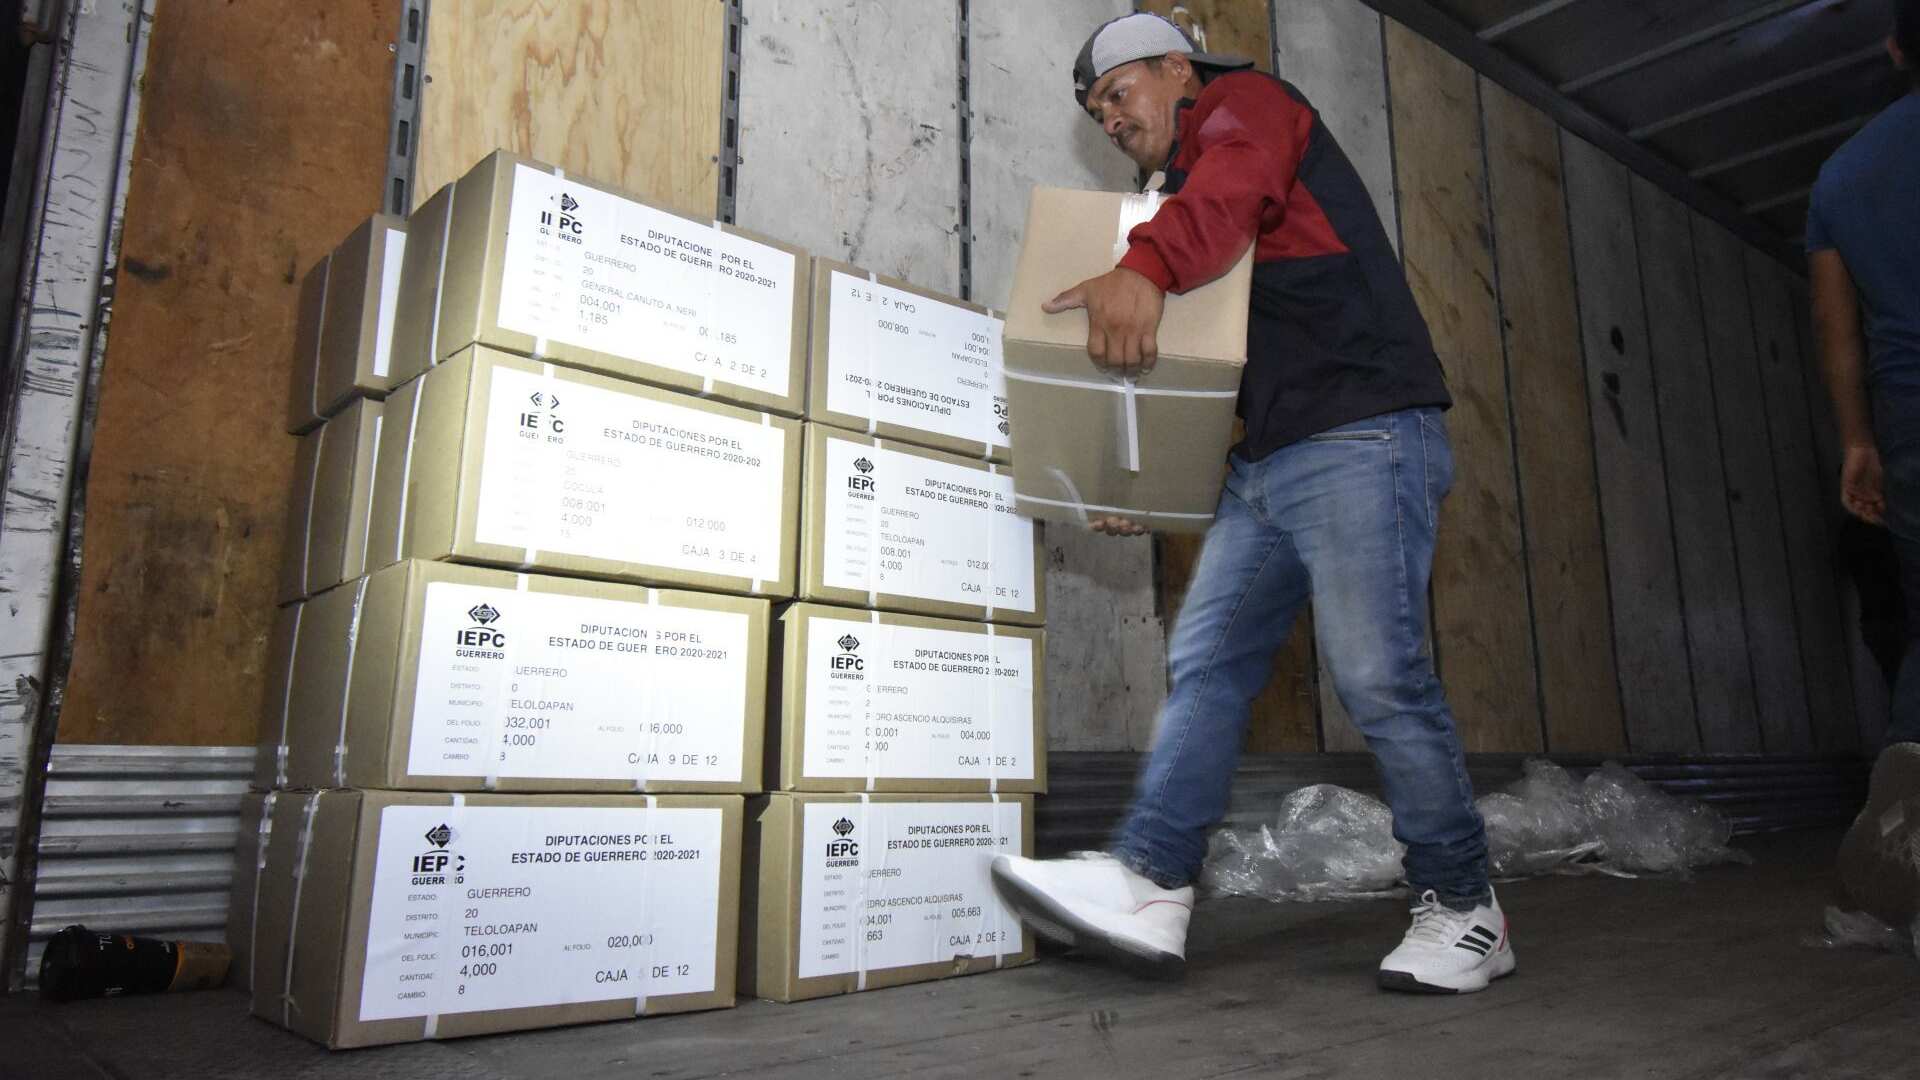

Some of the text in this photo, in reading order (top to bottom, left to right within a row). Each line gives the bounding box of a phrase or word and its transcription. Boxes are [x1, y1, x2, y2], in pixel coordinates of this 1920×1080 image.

[647, 229, 753, 269] DIPUTACIONE POR EL
[584, 250, 637, 273] GUERRERO
[620, 234, 776, 289] ESTADO DE GUERRRO 2020-2021
[851, 287, 859, 297] 12
[882, 296, 887, 305] 2
[729, 360, 735, 370] 2
[741, 363, 755, 375] DE
[760, 368, 766, 378] 2
[878, 392, 893, 403] POR
[884, 382, 969, 408] ESTADO DE GUERRERO
[896, 396, 950, 415] DIPUTACIONES
[520, 412, 564, 434] IEC
[632, 419, 741, 450] DIPUTACIONES POR EL
[603, 427, 760, 467] ESTADO DE GUERRERO 2020-202
[925, 478, 976, 495] DIPUTACIONES
[995, 492, 1002, 500] EL
[848, 491, 874, 501] GUERRER
[905, 486, 987, 509] ESTADO DE GUERRERO
[719, 549, 725, 559] 3
[730, 551, 744, 562] DE
[961, 582, 980, 593] CAJA
[995, 587, 1006, 596] DE
[456, 629, 505, 647] IEPC
[580, 623, 701, 642] DIPUTACIONS POR EL
[455, 649, 504, 659] GUERRERO
[548, 636, 727, 660] ESTADO DE GUERERO 2020-2021
[915, 649, 970, 661] DIPUTACIONES
[973, 654, 988, 662] POR
[830, 656, 863, 670] IEPC
[893, 660, 926, 670] ESTADO
[928, 663, 938, 671] DE
[941, 664, 983, 674] GUERRERO
[515, 665, 567, 677] UERRERO
[830, 672, 863, 680] GUERRERO
[866, 684, 908, 694] GERRERO
[511, 699, 573, 711] ELOLOAPAN
[668, 754, 717, 766] 9 DE 12
[958, 756, 1015, 765] CAJA 1 DE 2
[908, 824, 989, 834] DIPUTACIONES POR EL
[545, 834, 672, 845] DIPUTACIONES PO EL
[887, 840, 919, 849] ESTADO
[921, 839, 931, 848] DE
[934, 838, 974, 847] GUERRERO
[826, 843, 858, 856] IEPC
[511, 852, 561, 863] ESTADO
[565, 851, 580, 862] DE
[826, 859, 858, 867] GUERRERO
[411, 876, 464, 885] GUERRO
[467, 887, 531, 898] GUERRERO
[887, 893, 962, 906] ASCENCIO ALQUISIRAS
[465, 908, 478, 918] 20
[464, 923, 537, 936] TELOLOAPAN
[950, 935, 970, 946] CAJA
[976, 934, 981, 943] 2
[986, 932, 995, 942] DE
[461, 943, 512, 958] 016,001
[459, 962, 497, 978] 4,000
[595, 969, 628, 983] CAJA
[652, 966, 669, 978] DE
[676, 965, 688, 976] 12
[457, 985, 465, 995] 8
